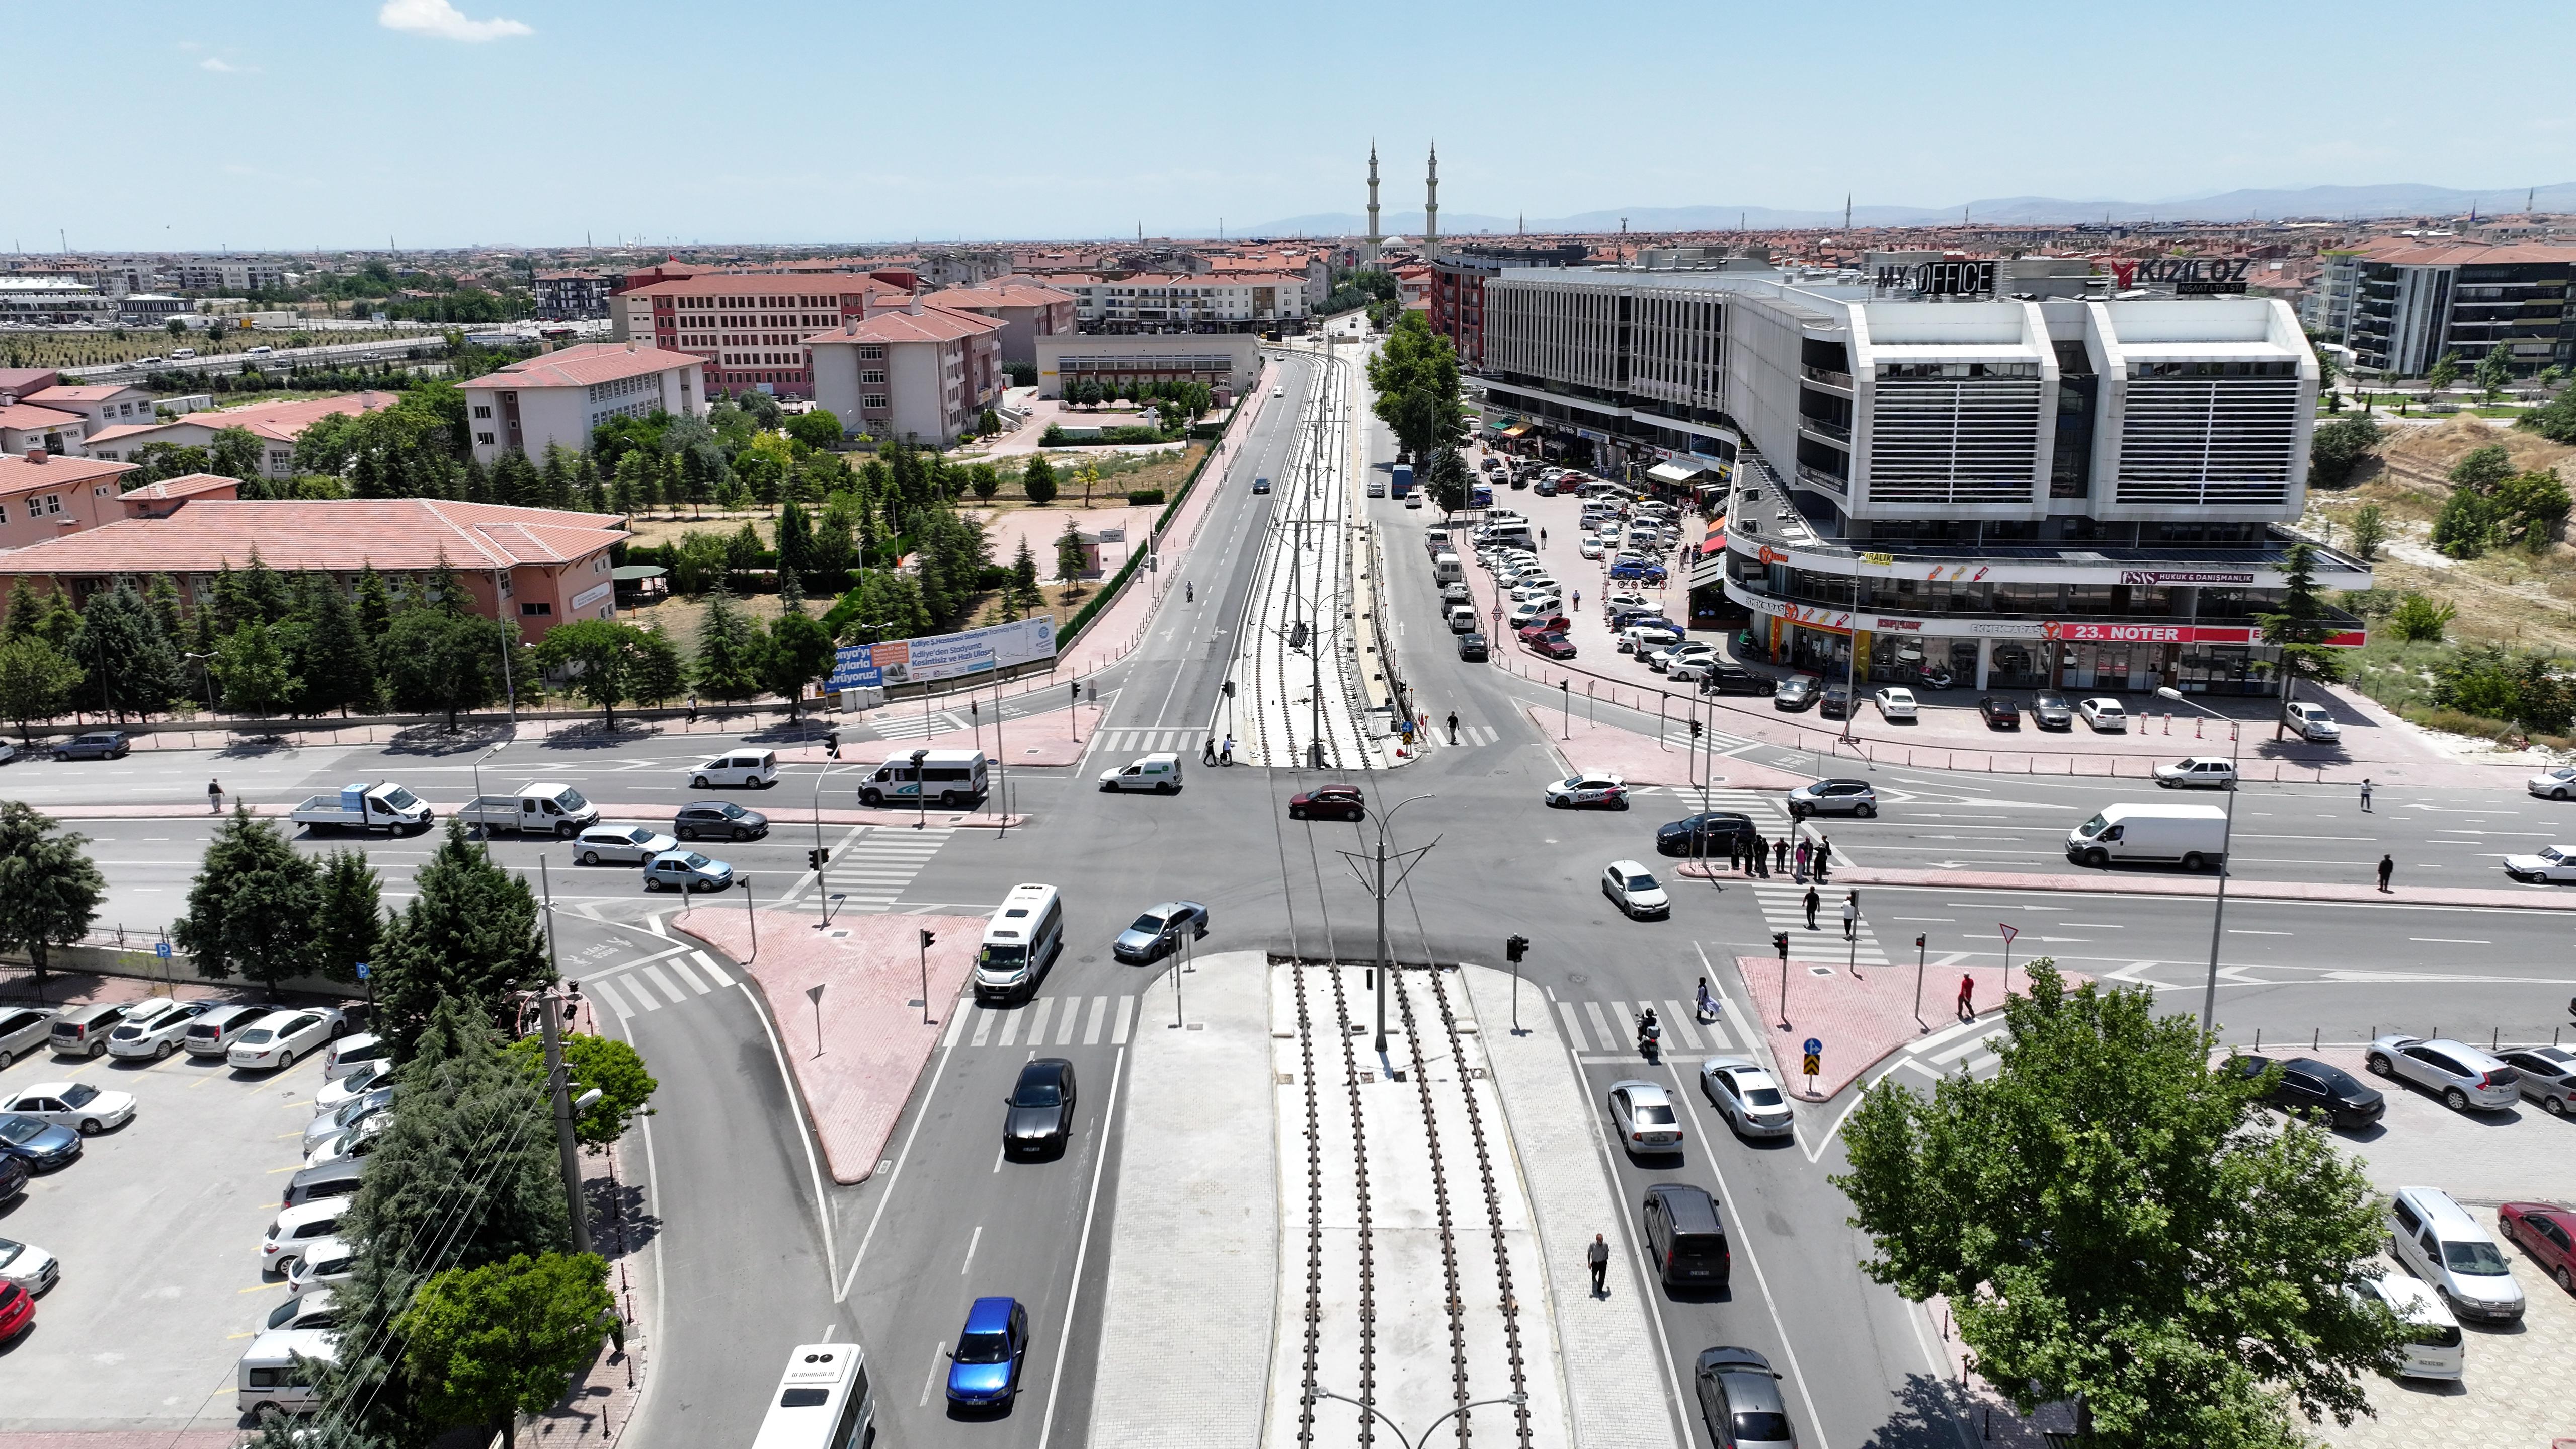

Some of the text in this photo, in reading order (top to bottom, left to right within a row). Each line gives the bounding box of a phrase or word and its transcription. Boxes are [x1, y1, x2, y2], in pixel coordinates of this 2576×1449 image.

[1878, 263, 1992, 293] MY OFFICE
[964, 631, 988, 641] Stadyum
[989, 627, 1010, 636] Tramvay
[1971, 624, 2005, 633] EKMEK
[2075, 626, 2179, 640] 23. NOTER
[835, 648, 870, 660] onya'yı
[912, 648, 949, 659] Adliye'den
[950, 642, 982, 653] Stadyuma
[912, 656, 947, 667] Kesintisiz
[958, 652, 973, 661] Hızlı
